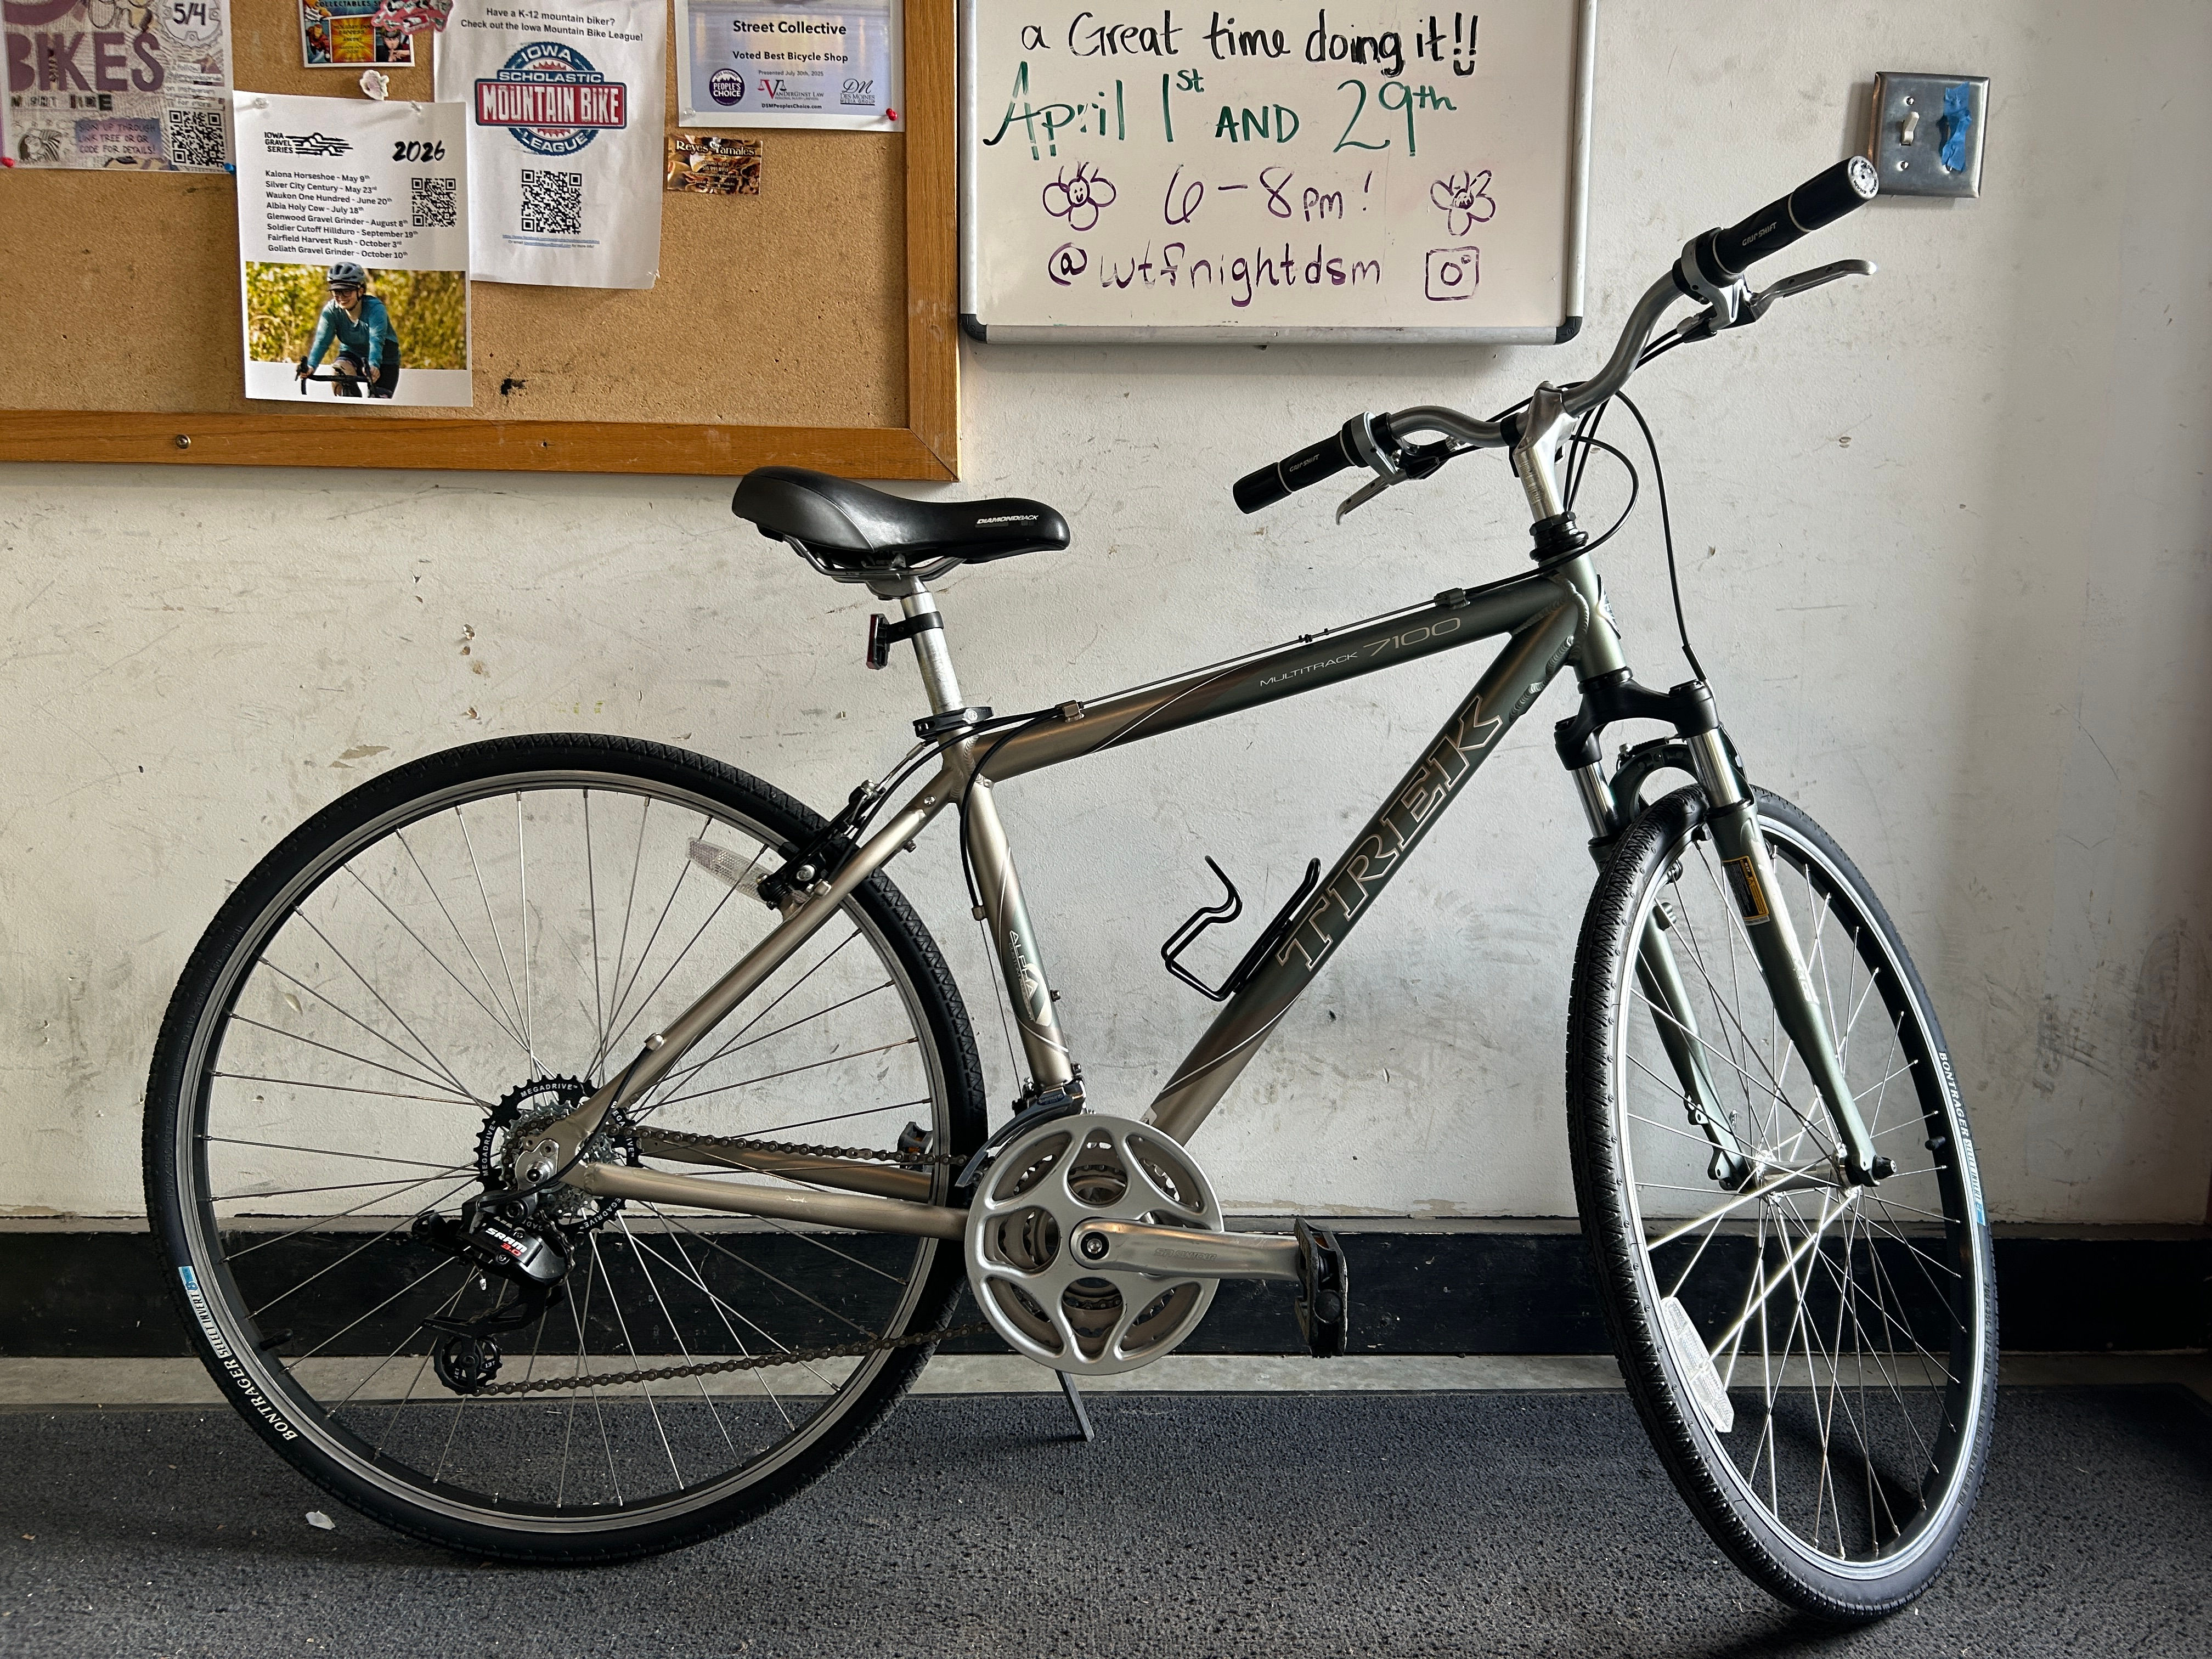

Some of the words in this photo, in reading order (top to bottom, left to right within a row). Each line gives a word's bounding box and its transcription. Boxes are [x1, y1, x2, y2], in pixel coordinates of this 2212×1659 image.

[173, 3, 206, 26] 5/4
[486, 8, 508, 18] Have
[518, 9, 539, 19] K-12
[541, 12, 584, 23] mountain
[586, 16, 616, 27] biker?
[461, 19, 487, 29] Check
[489, 21, 504, 30] out
[506, 21, 519, 30] the
[521, 22, 541, 32] Iowa
[544, 25, 584, 36] Mountain
[587, 29, 606, 38] Bike
[608, 31, 644, 42] League!
[732, 20, 774, 33] Street
[778, 20, 847, 35] Collective
[1022, 25, 1051, 50] a
[1068, 10, 1183, 56] Great
[1202, 11, 1291, 60] time
[1304, 9, 1406, 77] doing
[5, 31, 164, 92] BIKES
[521, 44, 573, 63] IOWA
[732, 50, 761, 60] Voted
[764, 51, 785, 60] Best
[788, 52, 821, 63] Bicycle
[823, 53, 849, 63] Shop
[499, 72, 602, 83] SCHOLASTIC
[713, 82, 741, 91] PEOPLE'S
[483, 84, 574, 122] MOUNTAIN
[581, 87, 620, 124] BIKE
[983, 61, 1125, 161] April
[1215, 104, 1300, 143] AND
[1333, 79, 1457, 156] 29th
[117, 123, 156, 133] THROUGH
[100, 134, 120, 142] TREE
[125, 134, 136, 143] OR
[521, 132, 588, 153] LEAGUE
[676, 140, 709, 154] Reyes
[79, 145, 99, 154] CODE
[103, 145, 120, 153] FOR
[123, 145, 156, 155] DETAILS!
[392, 140, 446, 163] 2026
[294, 172, 335, 180] Horseshoe
[342, 174, 358, 183] May
[290, 182, 305, 191] City
[307, 183, 338, 193] Century
[345, 185, 361, 194] May
[317, 194, 350, 202] Hundred
[288, 203, 306, 212] Holy
[331, 206, 348, 215] July
[267, 213, 306, 222] Glenwood
[371, 219, 397, 228] August
[267, 223, 295, 232] Soldier
[324, 227, 355, 235] Hillduro
[362, 229, 403, 238] September
[298, 246, 323, 255] Gravel
[325, 248, 354, 256] Grinder
[362, 250, 392, 258] October
[977, 515, 1039, 524] DIAMONDBACK
[1260, 651, 1358, 687] MULTITRACK
[1363, 617, 1460, 657] 7100
[1276, 693, 1502, 971] TREK
[1009, 930, 1034, 1001] ALPHA
[1939, 1052, 1968, 1139] BONTRAGER
[1964, 1139, 1975, 1173] SELECT
[1971, 1173, 1981, 1200] INVERT
[486, 1227, 528, 1254] SRAM
[500, 1242, 522, 1257] 3.0
[190, 1293, 210, 1323] INVERT
[206, 1325, 231, 1357] SELECT
[224, 1358, 299, 1441] BONTRAGER
